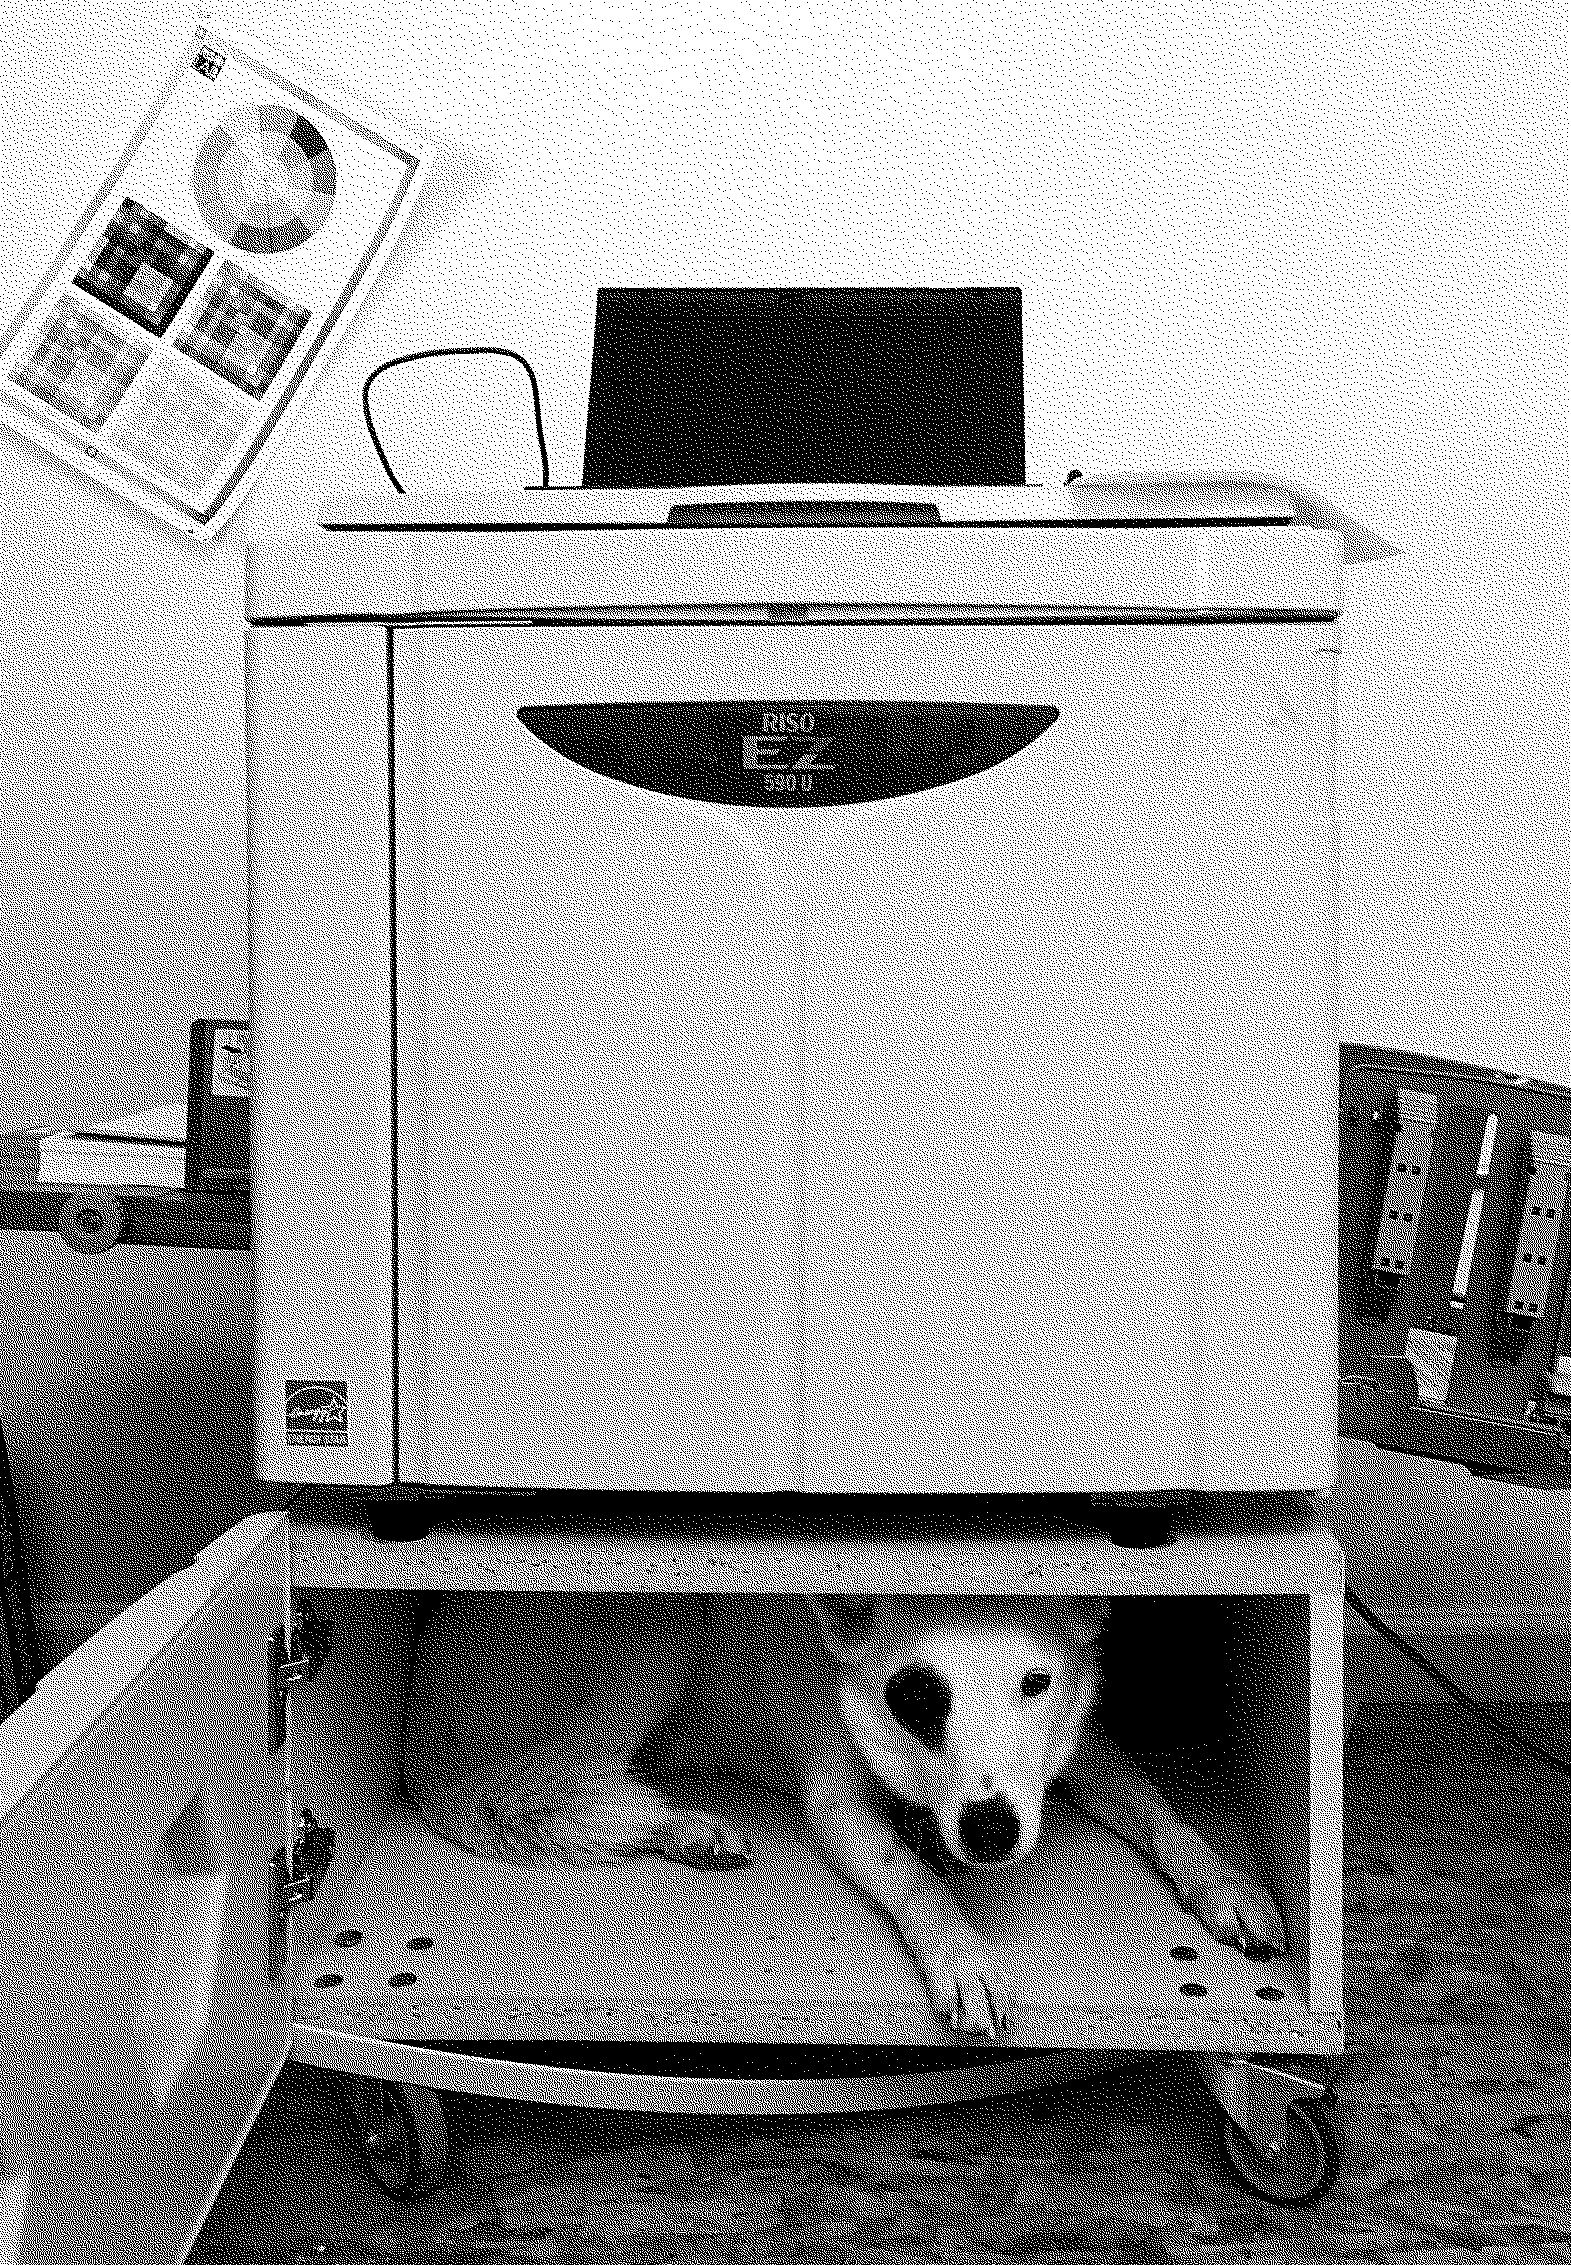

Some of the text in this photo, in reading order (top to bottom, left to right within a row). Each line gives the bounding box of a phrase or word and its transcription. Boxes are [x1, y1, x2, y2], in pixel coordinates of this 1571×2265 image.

[763, 712, 815, 732] RISO
[742, 736, 835, 770] EZ
[764, 773, 813, 792] 590 U
